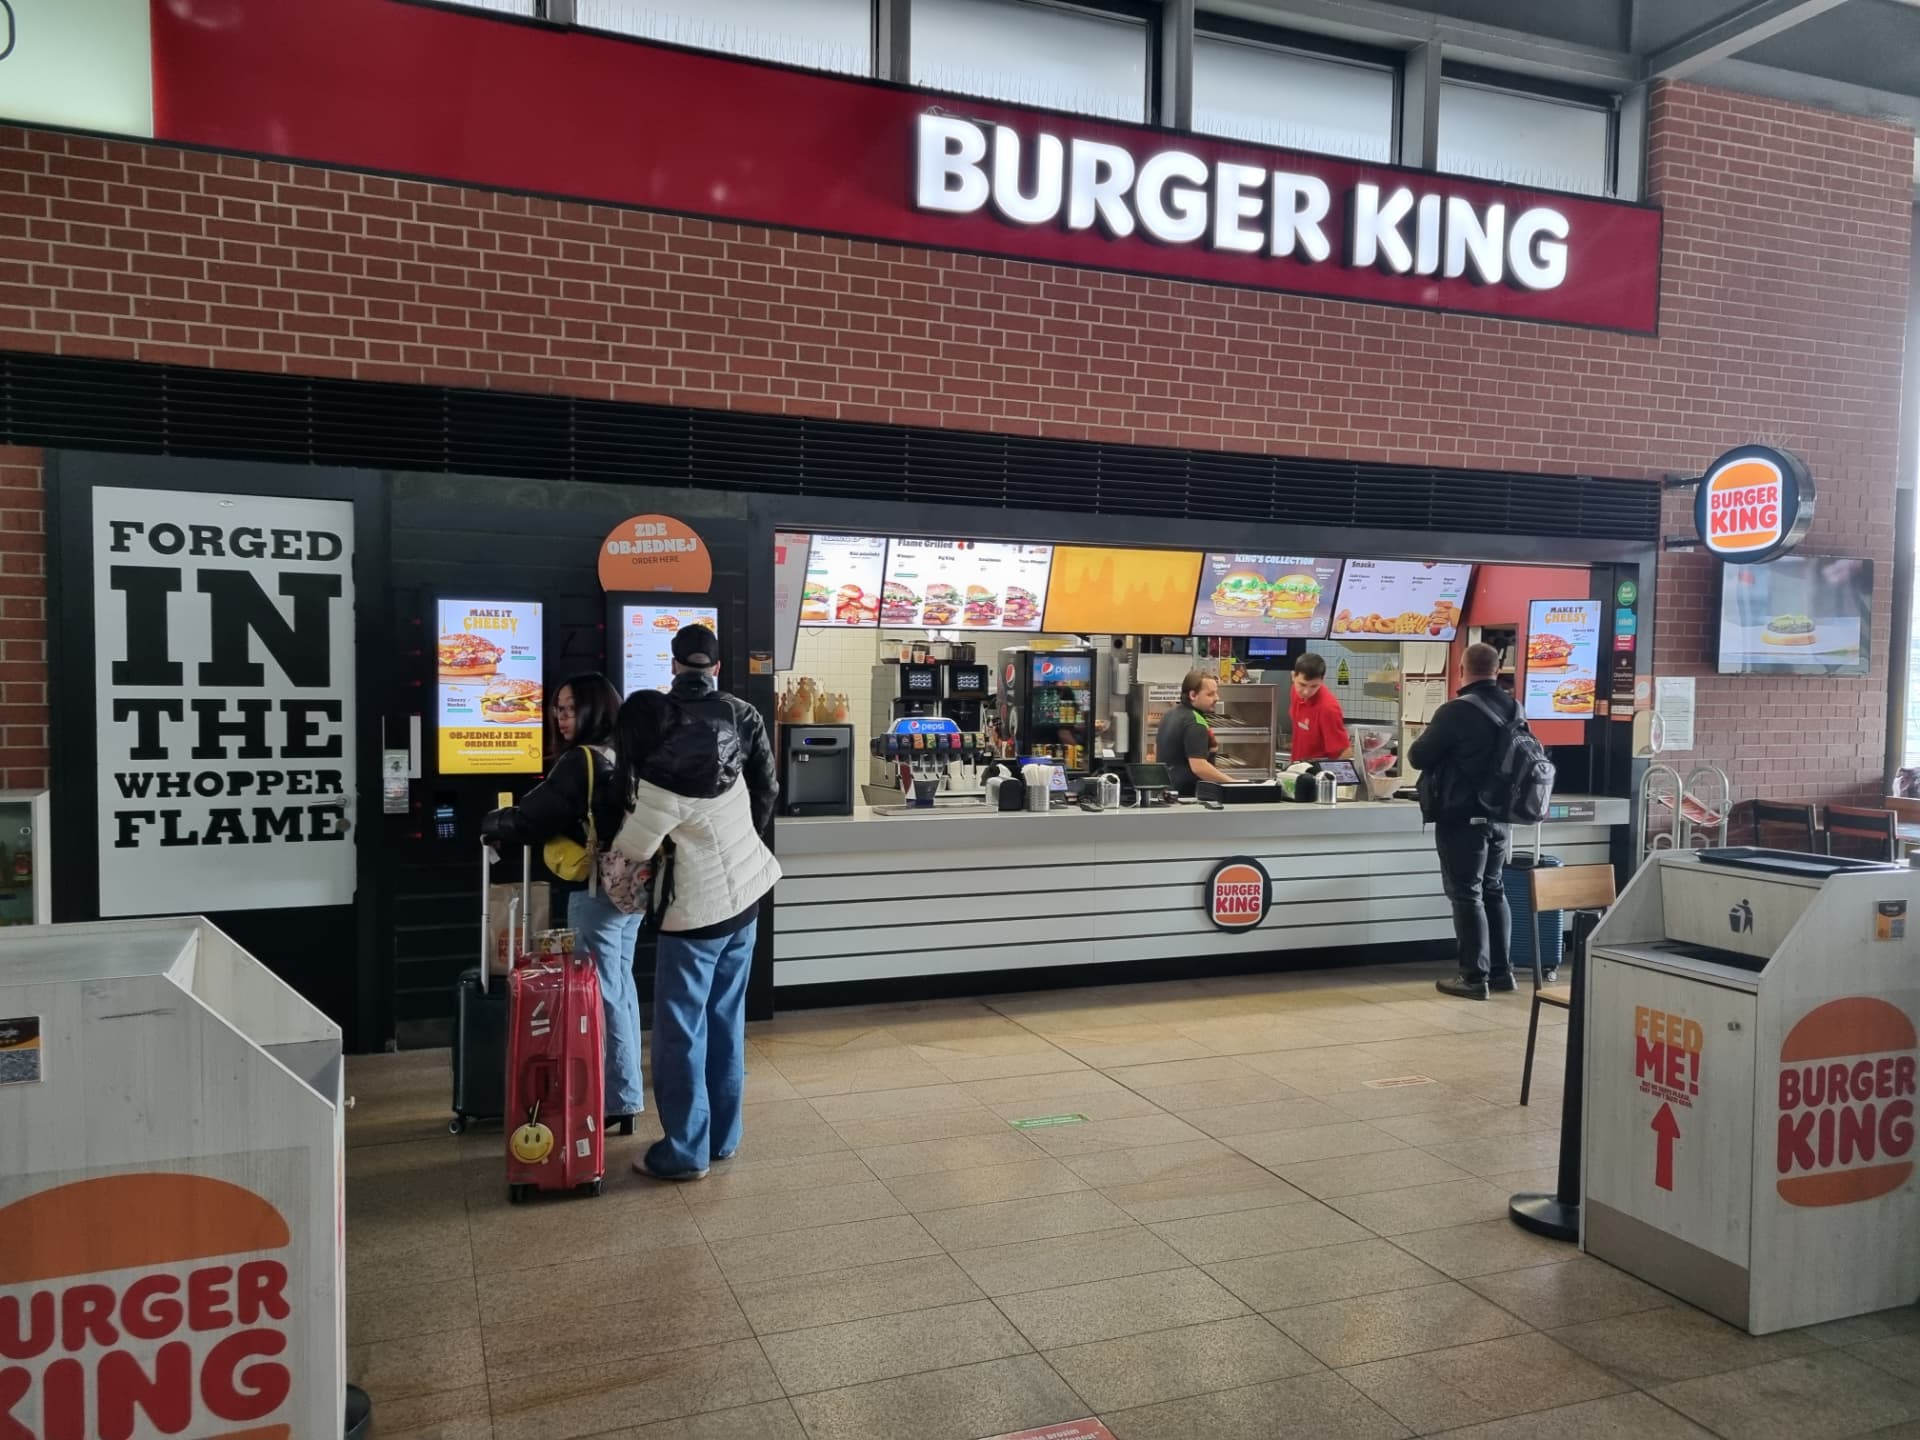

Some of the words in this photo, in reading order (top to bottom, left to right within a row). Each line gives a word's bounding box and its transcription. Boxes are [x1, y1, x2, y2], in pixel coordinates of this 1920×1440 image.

[917, 112, 1331, 263] BURGER
[1351, 183, 1569, 290] KING
[1711, 486, 1778, 510] BURGER
[1710, 504, 1778, 534] KING
[634, 523, 667, 537] ZDE
[110, 520, 343, 561] FORGED
[607, 538, 697, 555] OBJEDNEJ
[632, 556, 658, 565] ORDER
[660, 555, 680, 563] HERE
[1265, 555, 1315, 566] COLLECTION
[1352, 561, 1376, 569] Snacks
[469, 608, 500, 617] MAKE
[1544, 613, 1588, 625] CHEESY
[110, 565, 343, 688] IN
[463, 617, 519, 633] CHEESY
[1055, 664, 1080, 674] pepsi
[113, 698, 343, 760] THE
[921, 722, 945, 731] pepsi
[449, 731, 502, 740] OBJEDNEJ
[503, 731, 513, 739] SI
[515, 731, 533, 739] ZDE
[464, 740, 495, 748] ORDER
[114, 770, 344, 798] WHOPPER
[114, 806, 345, 848] FLAME
[1216, 885, 1260, 896] BURGER
[1216, 896, 1260, 913] KING
[1635, 1005, 1703, 1053] FEED
[1635, 1035, 1700, 1096] ME!
[1778, 1056, 1917, 1110] BURGER
[1777, 1100, 1915, 1174] KING
[0, 1259, 291, 1360] URGER
